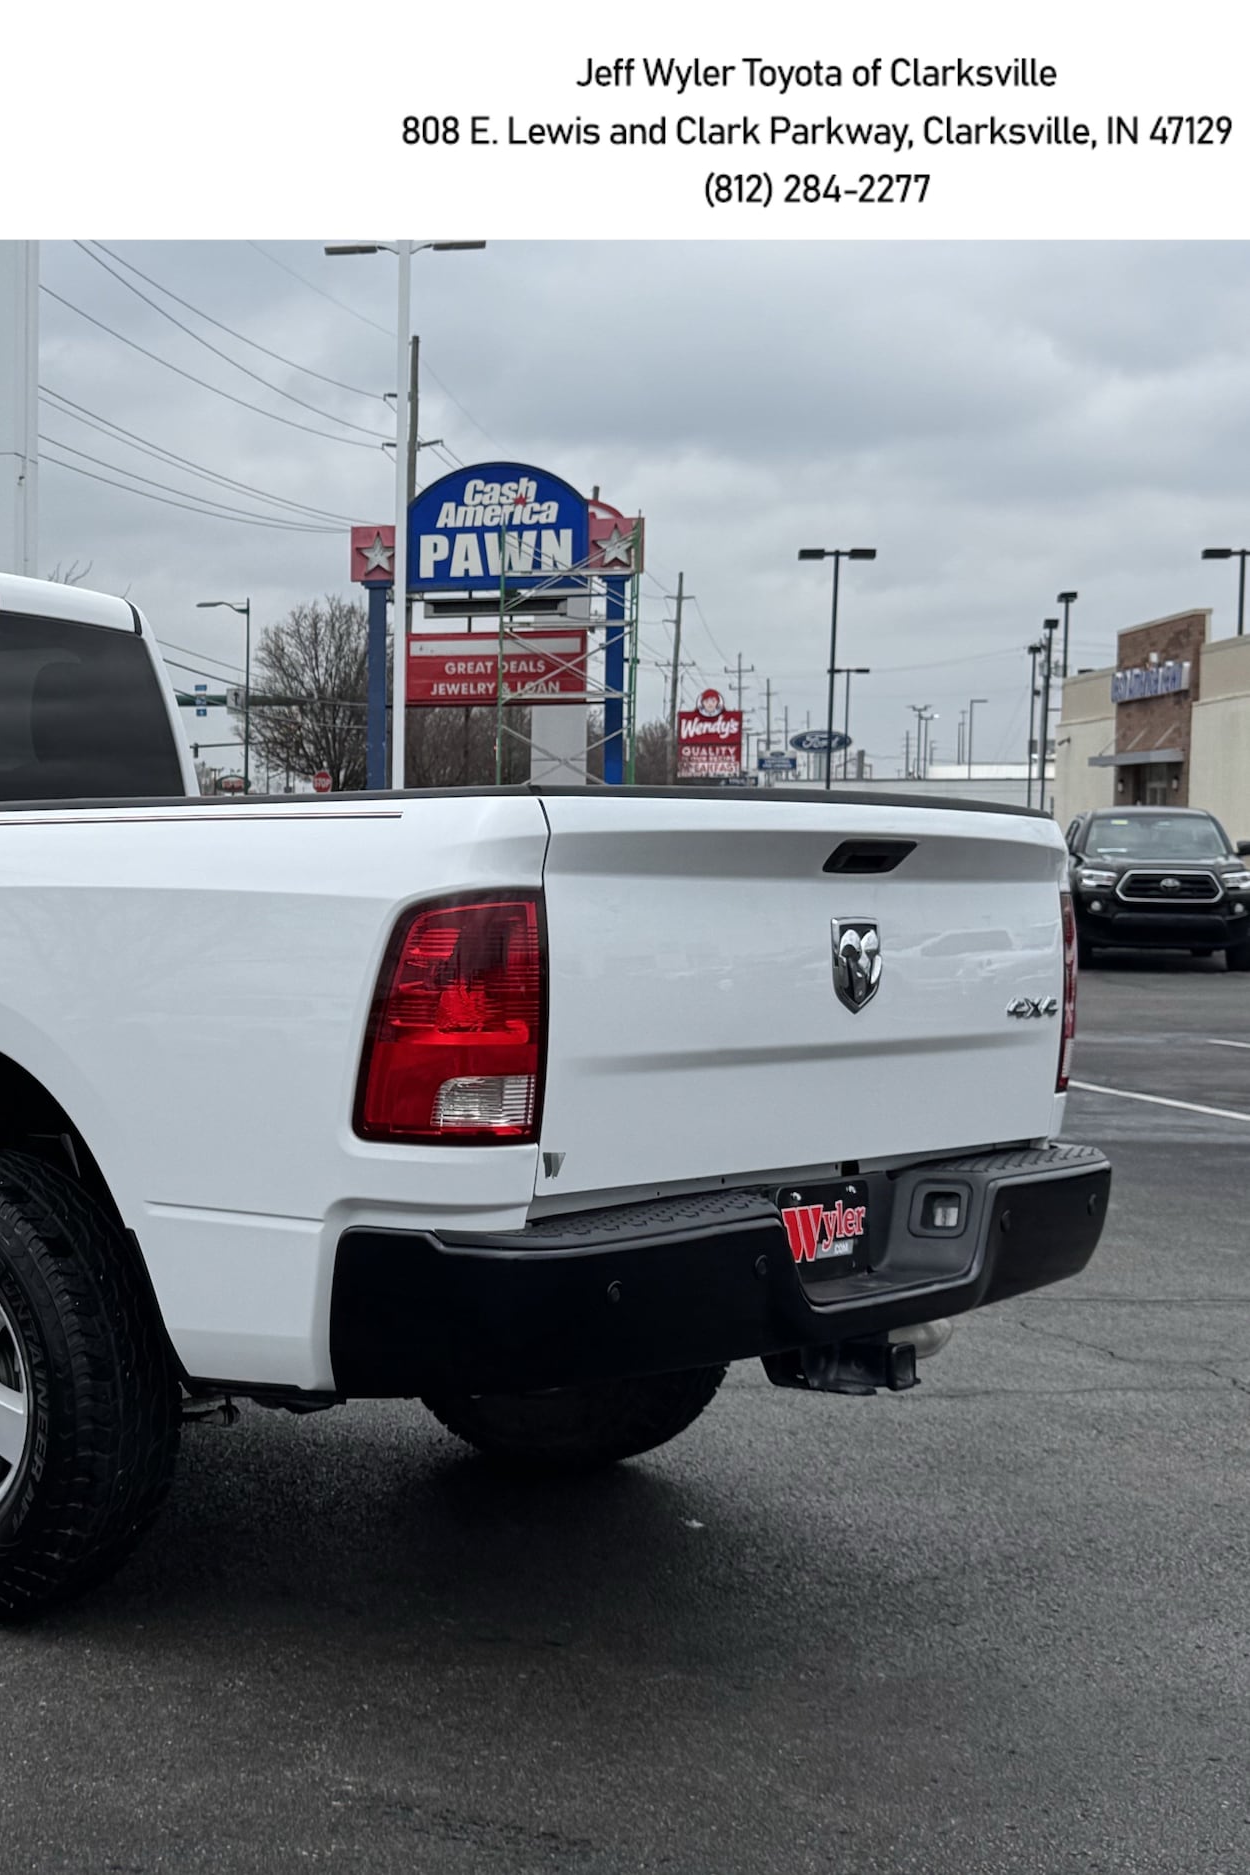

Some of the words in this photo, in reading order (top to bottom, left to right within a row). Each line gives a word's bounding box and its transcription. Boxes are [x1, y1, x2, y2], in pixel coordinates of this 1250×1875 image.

[463, 477, 538, 505] Cash
[436, 501, 559, 528] America
[419, 528, 573, 579] PAWN
[444, 661, 493, 675] GREAT
[500, 660, 546, 673] DEALS
[430, 682, 496, 696] JEWELRY
[516, 681, 560, 693] LOAN
[680, 717, 739, 739] Wendy's
[802, 733, 839, 749] Ford
[681, 746, 736, 756] QUALITY
[314, 776, 332, 789] STOP
[781, 1199, 866, 1264] Wyler
